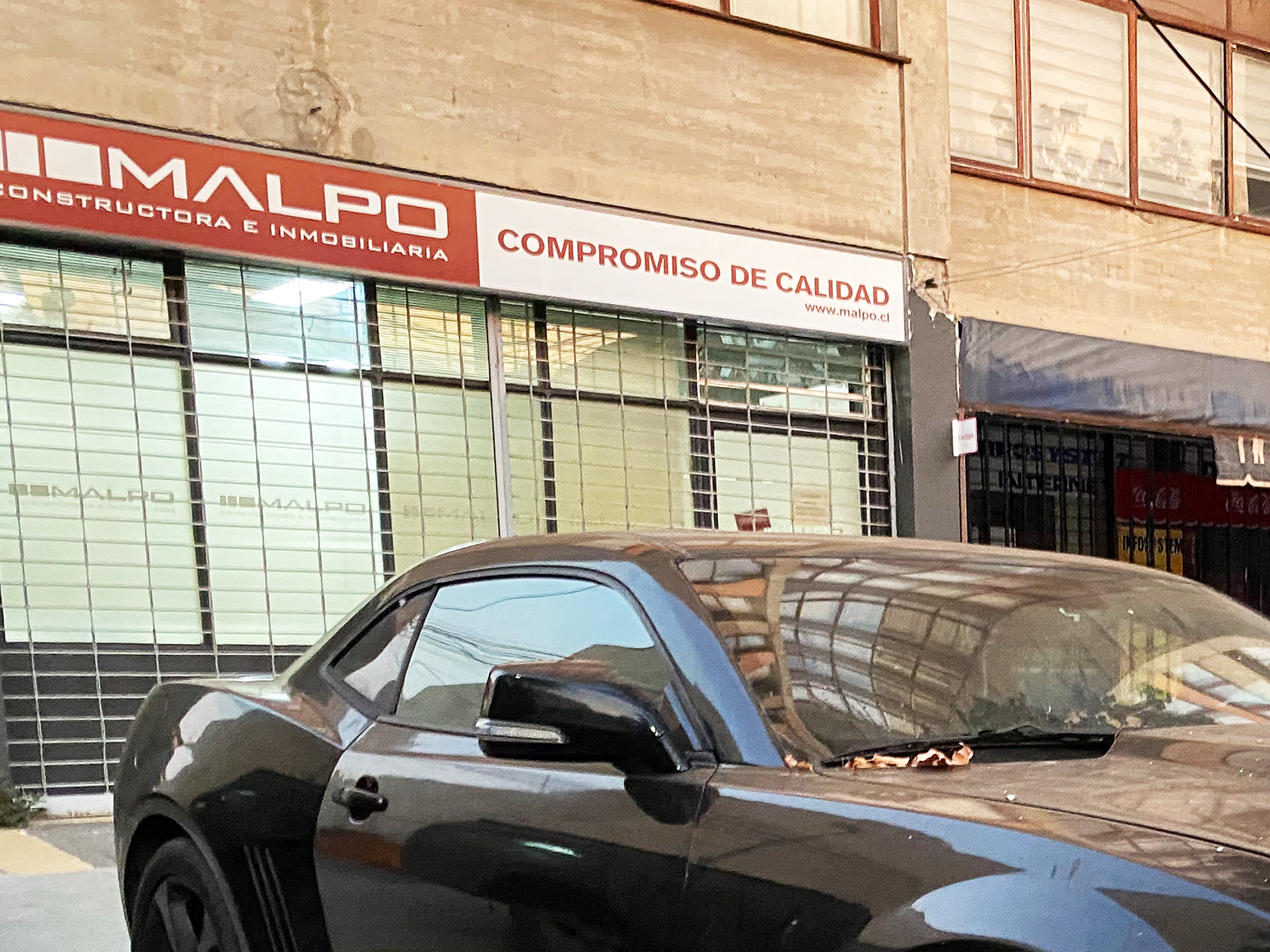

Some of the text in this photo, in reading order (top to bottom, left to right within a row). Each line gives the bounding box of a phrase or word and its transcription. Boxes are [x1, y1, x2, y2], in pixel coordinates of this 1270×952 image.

[108, 147, 448, 239] MALPO
[0, 185, 449, 262] ONSTRUCTORA E INMOBILIARIA
[497, 228, 891, 306] COMPROMISO DE CALIDAD
[804, 302, 891, 324] www.malpo.cl
[52, 485, 175, 503] MALPO
[261, 498, 367, 514] MALPO
